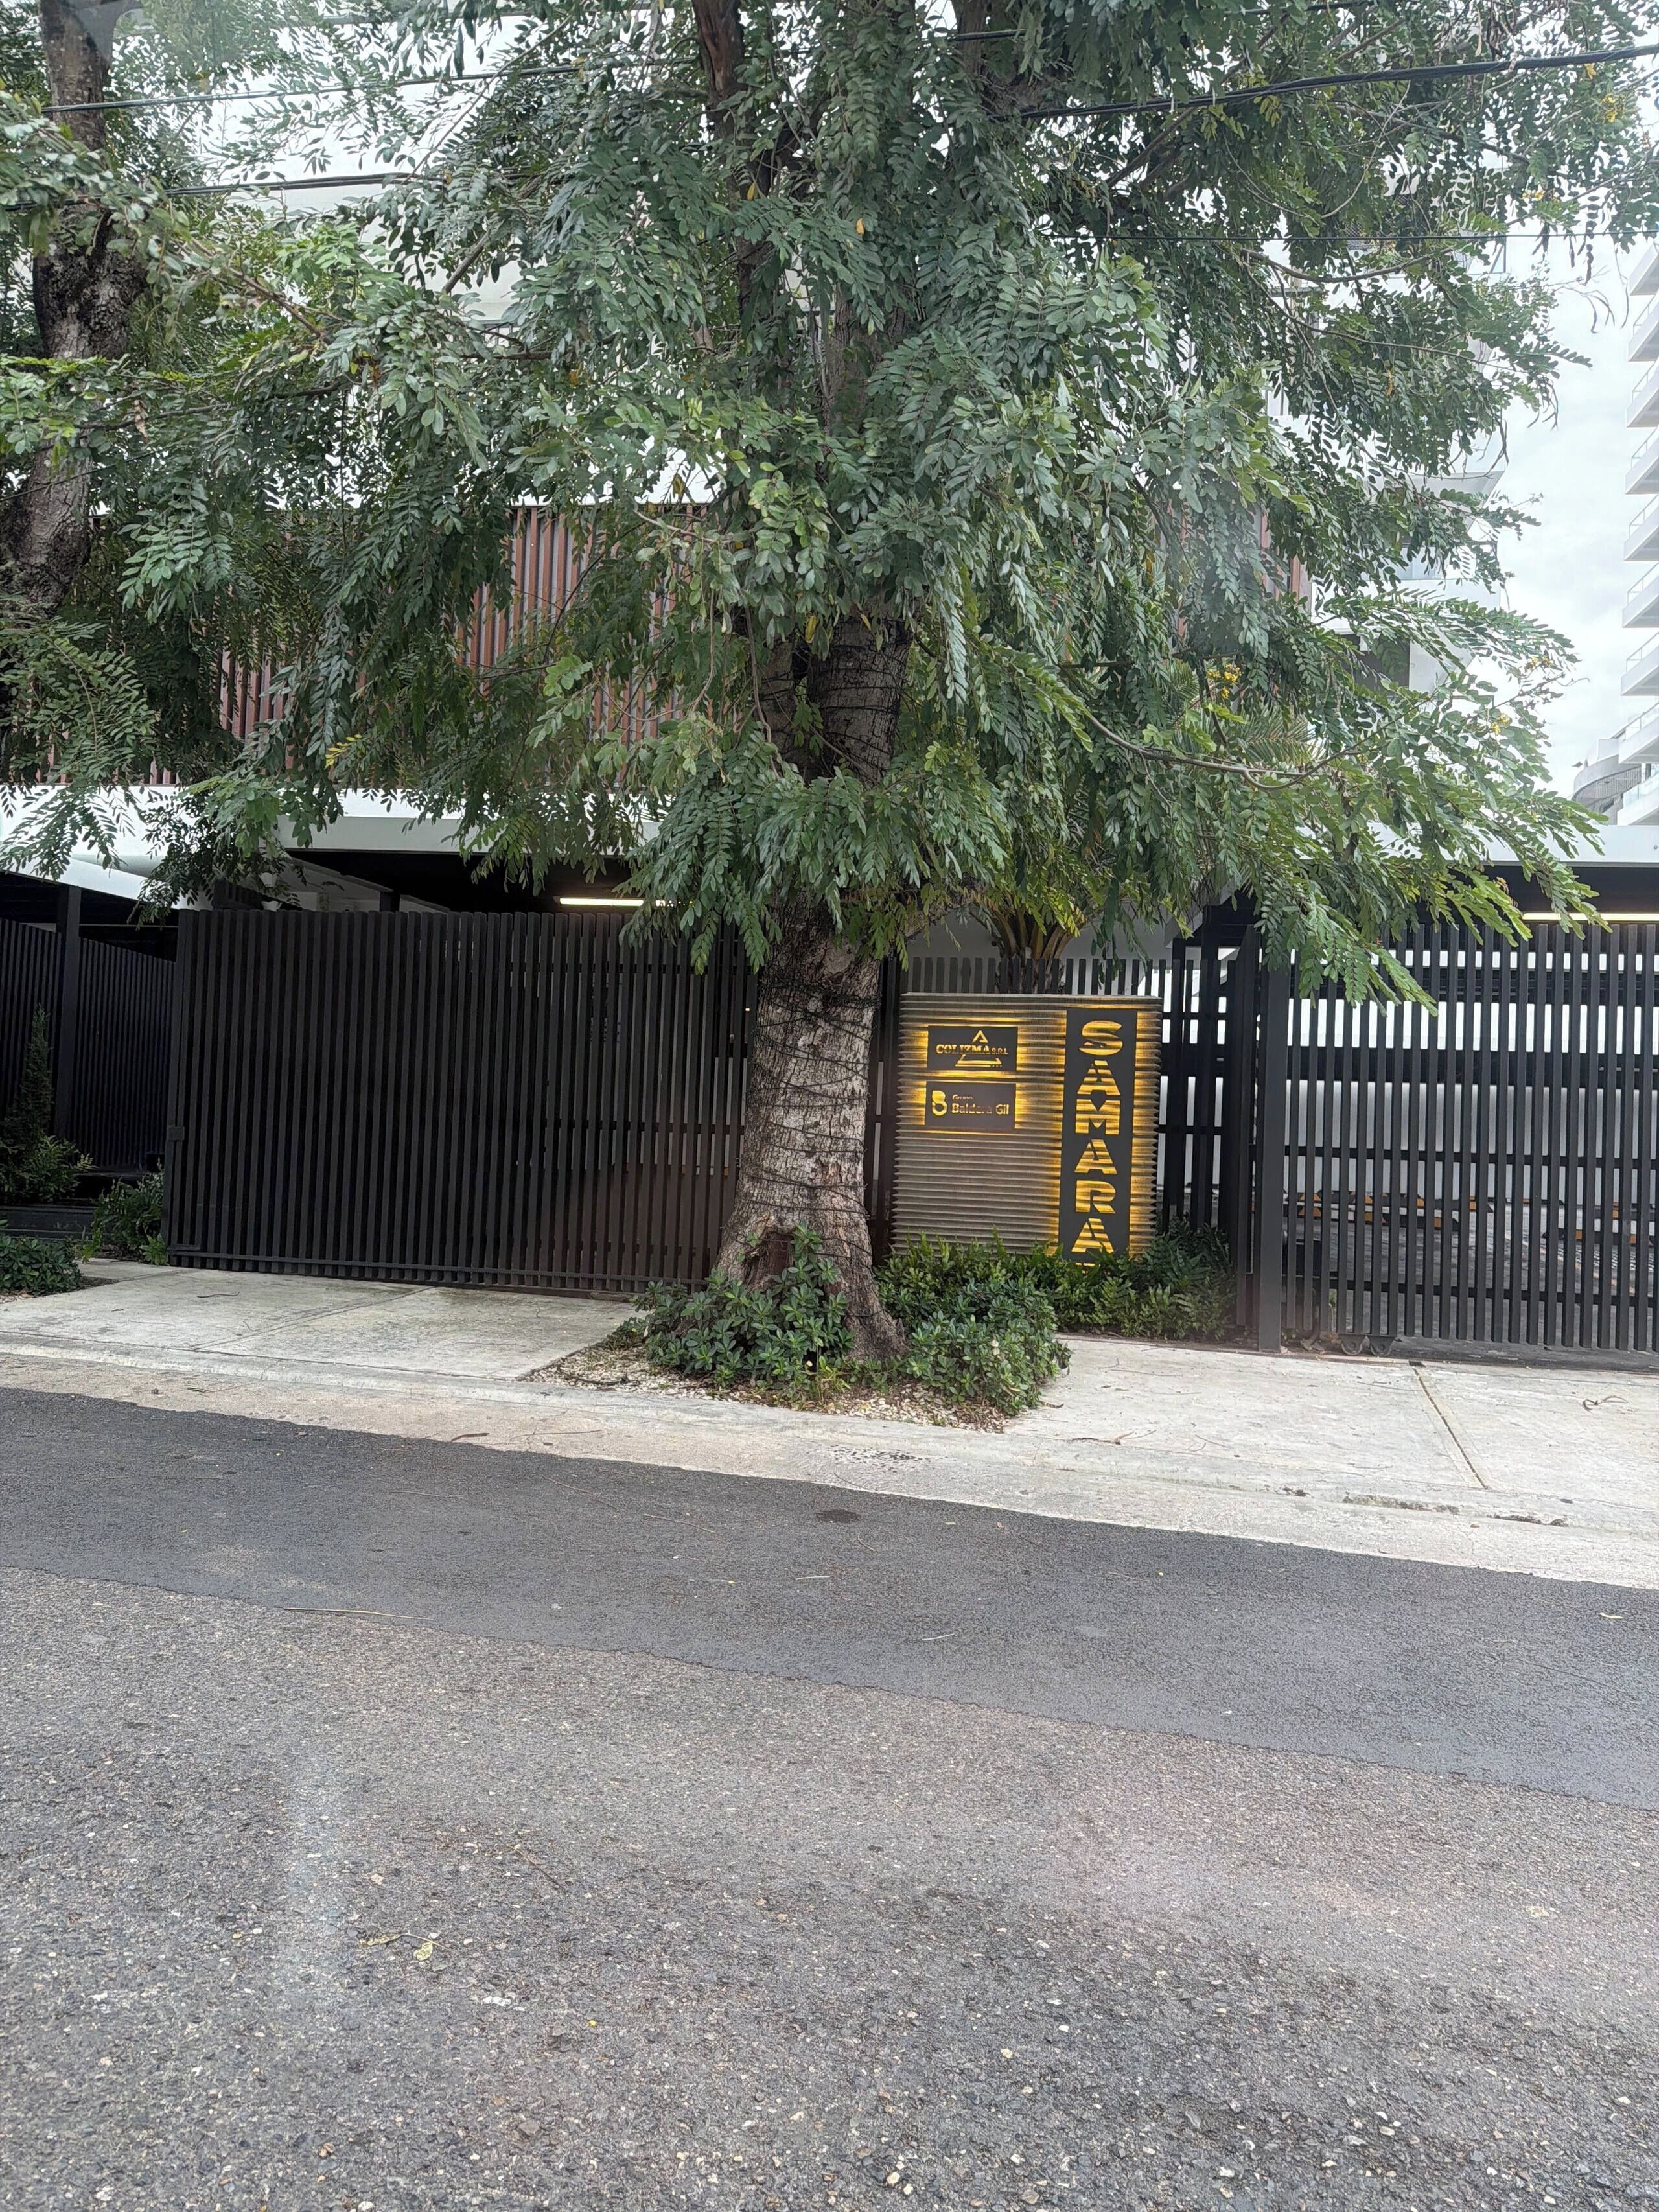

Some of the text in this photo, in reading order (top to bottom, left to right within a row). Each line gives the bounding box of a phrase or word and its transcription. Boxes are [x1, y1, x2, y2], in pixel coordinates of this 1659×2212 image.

[935, 1043, 991, 1054] COLIZMA
[995, 1104, 1010, 1115] Gil
[1071, 1019, 1124, 1254] SAMARA
